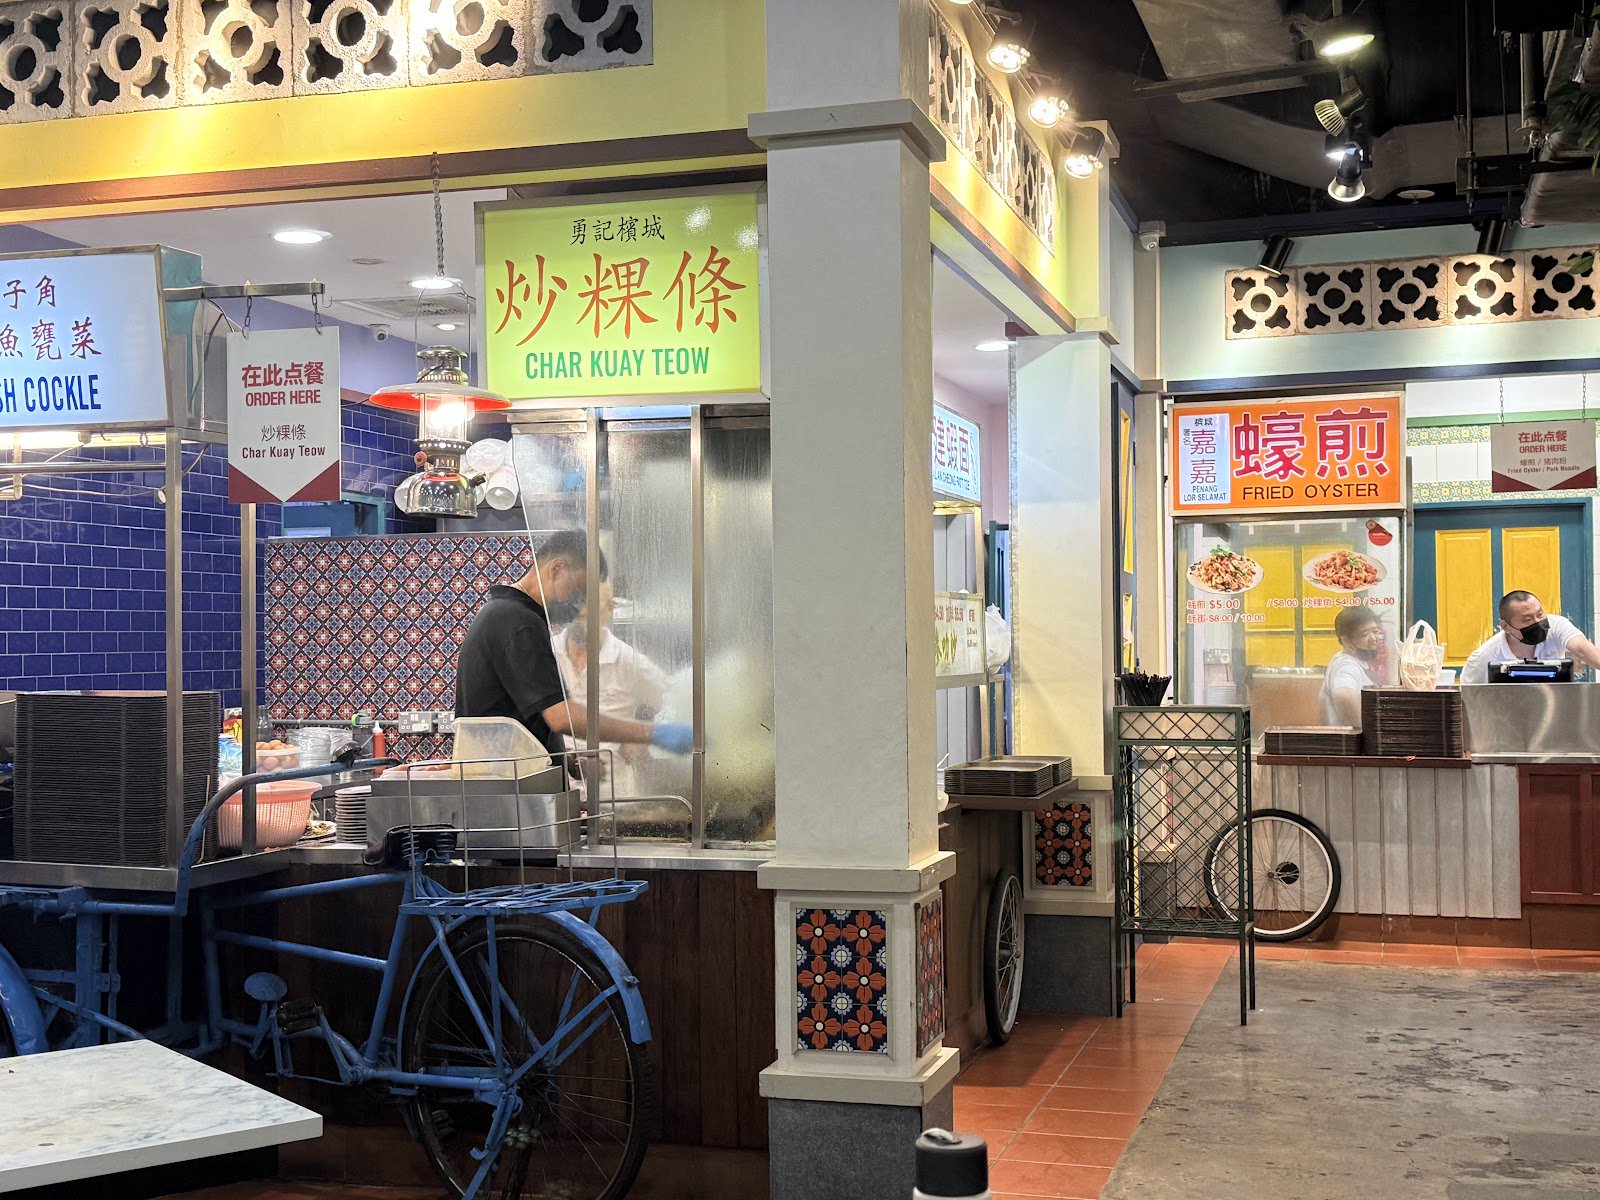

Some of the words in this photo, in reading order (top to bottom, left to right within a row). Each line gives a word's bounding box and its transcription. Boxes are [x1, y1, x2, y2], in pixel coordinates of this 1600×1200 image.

[570, 214, 665, 246] 勇記檳城
[495, 246, 747, 346] 炒粿條
[526, 351, 582, 380] CHAR
[590, 348, 646, 378] KUAY
[652, 346, 710, 375] TEOW
[242, 361, 324, 389] 在此点餐
[24, 374, 102, 412] COCKLE
[245, 390, 286, 407] ORDER
[290, 390, 321, 405] HERE
[260, 423, 306, 442] 炒粿條
[1518, 430, 1568, 444] 在此点餐
[1233, 407, 1390, 480] 蠔煎
[1520, 445, 1545, 454] ORDER
[1548, 444, 1568, 452] HERE
[242, 446, 266, 460] Char
[270, 446, 295, 460] Kuay
[298, 445, 326, 457] Teow
[1192, 485, 1218, 493] PENANG
[1198, 493, 1226, 501] SELAMAT
[1242, 486, 1294, 500] FRIED
[1304, 483, 1379, 498] OYSTER
[1209, 598, 1240, 609] $5.00
[1273, 598, 1298, 608] $8.00
[1335, 597, 1361, 607] $4.00
[1369, 597, 1395, 606] $5.00
[1241, 613, 1266, 622] 10.00
